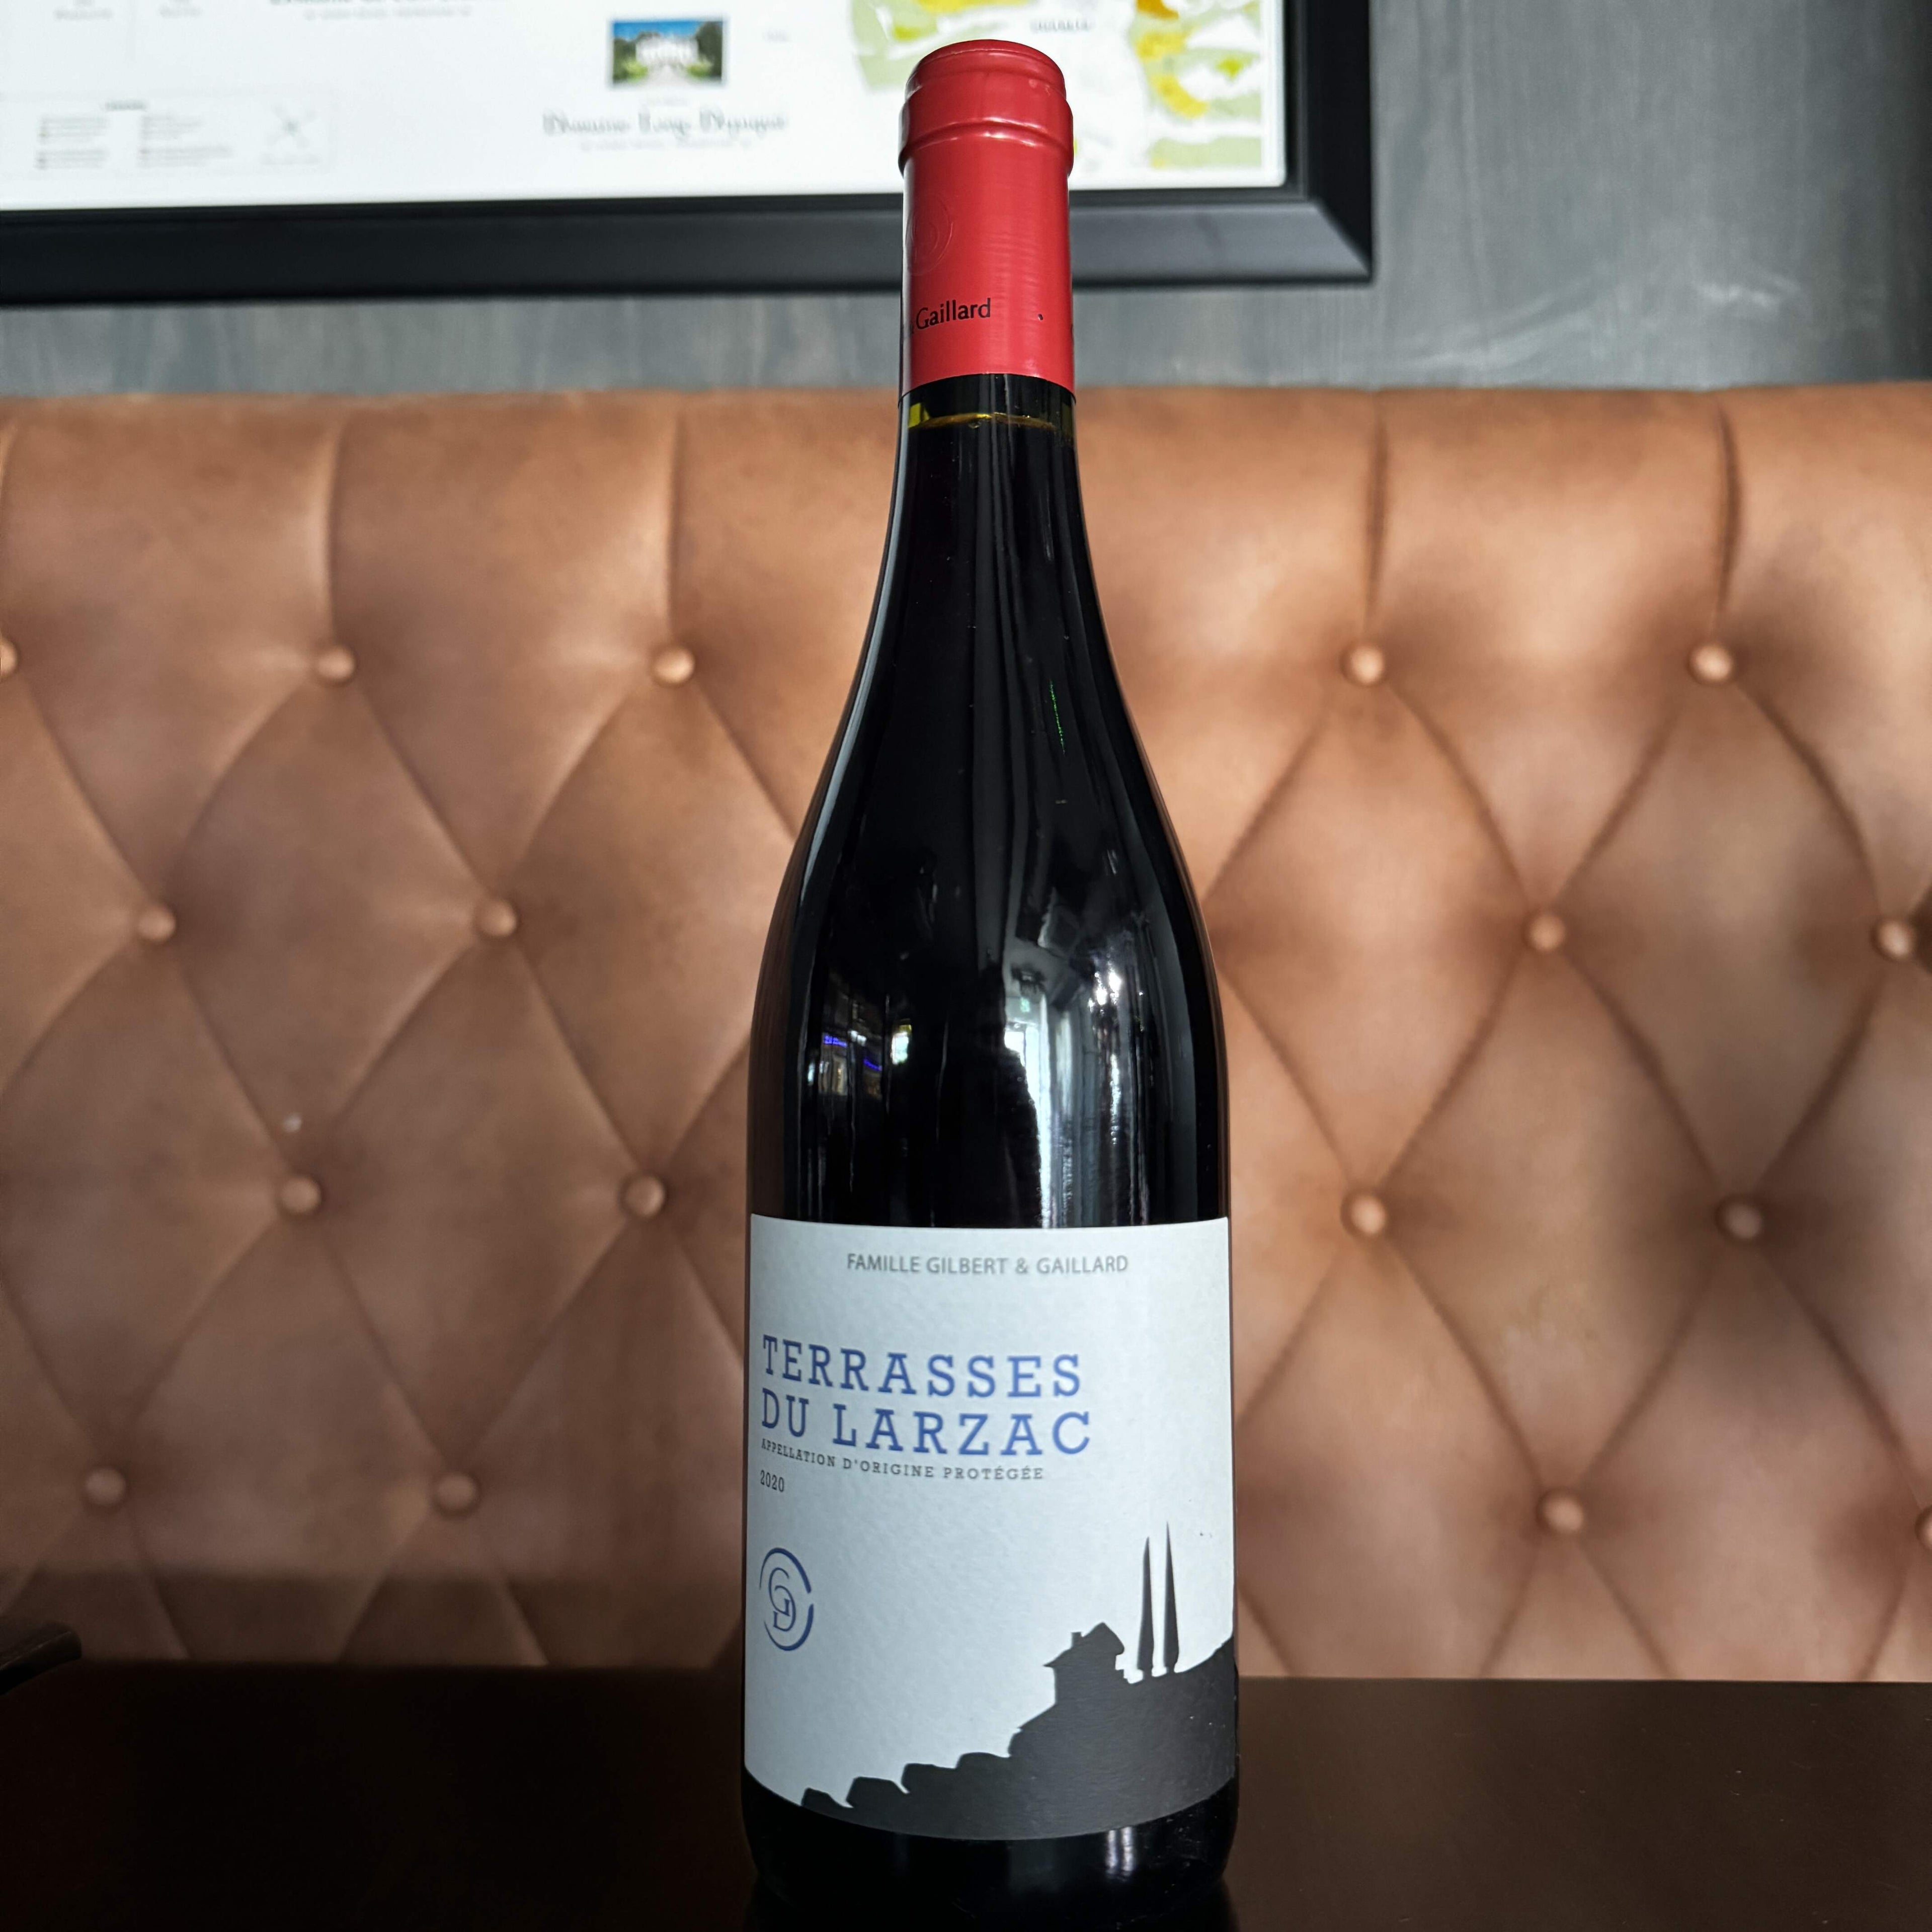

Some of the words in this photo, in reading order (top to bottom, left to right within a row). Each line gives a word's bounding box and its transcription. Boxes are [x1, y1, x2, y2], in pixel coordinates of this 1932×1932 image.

[915, 297, 991, 330] Gaillard
[847, 1253, 920, 1273] FAMILLE
[926, 1257, 1008, 1275] GILBERT
[1015, 1258, 1028, 1275] &
[1036, 1255, 1129, 1275] GAILLARD
[763, 1334, 1081, 1398] TERRASSES
[761, 1387, 810, 1437] DU
[832, 1403, 1091, 1457] LARZAC
[761, 1437, 835, 1467] APPELLATION
[843, 1458, 934, 1478] D'ORIGINE
[943, 1463, 1043, 1480] PROTÉGÉE
[760, 1469, 785, 1493] 2020
